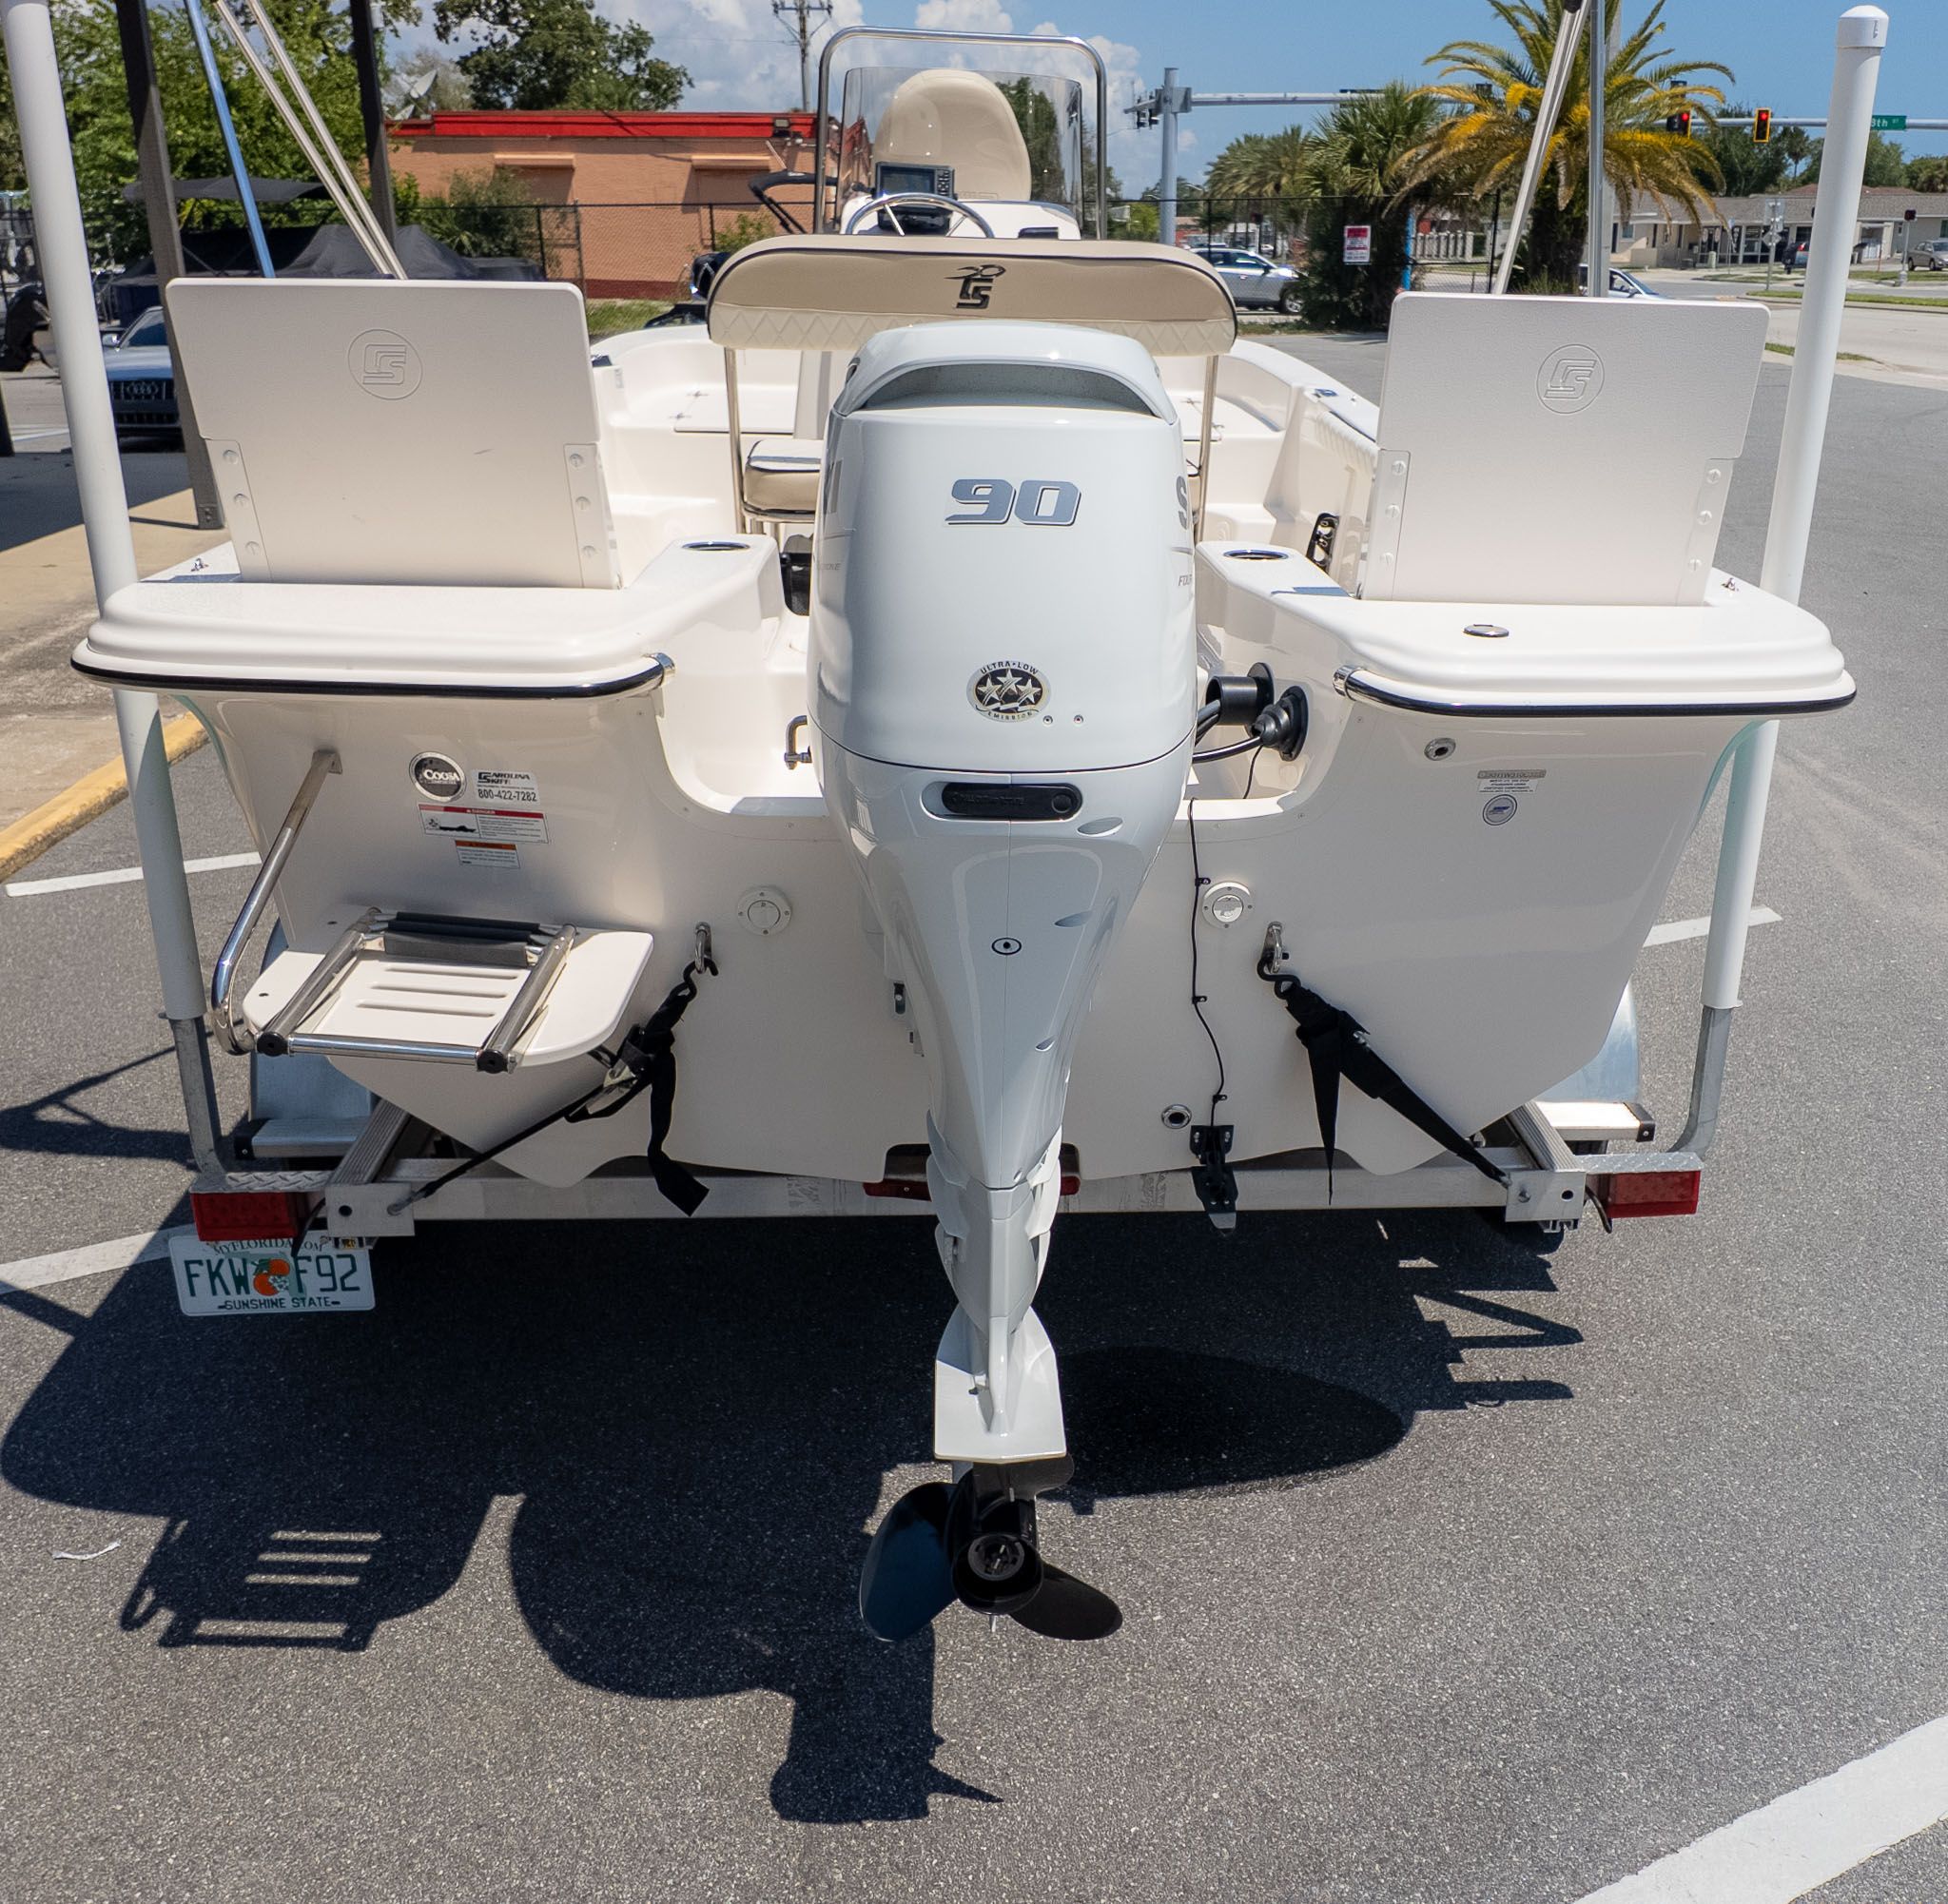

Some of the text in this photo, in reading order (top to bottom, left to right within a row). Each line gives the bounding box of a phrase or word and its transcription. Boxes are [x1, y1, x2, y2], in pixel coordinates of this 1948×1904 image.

[945, 478, 1081, 527] 90
[477, 788, 538, 802] 800-422-7282
[184, 1253, 360, 1297] FKW F92
[224, 1295, 332, 1311] SUNSHINE STATE
